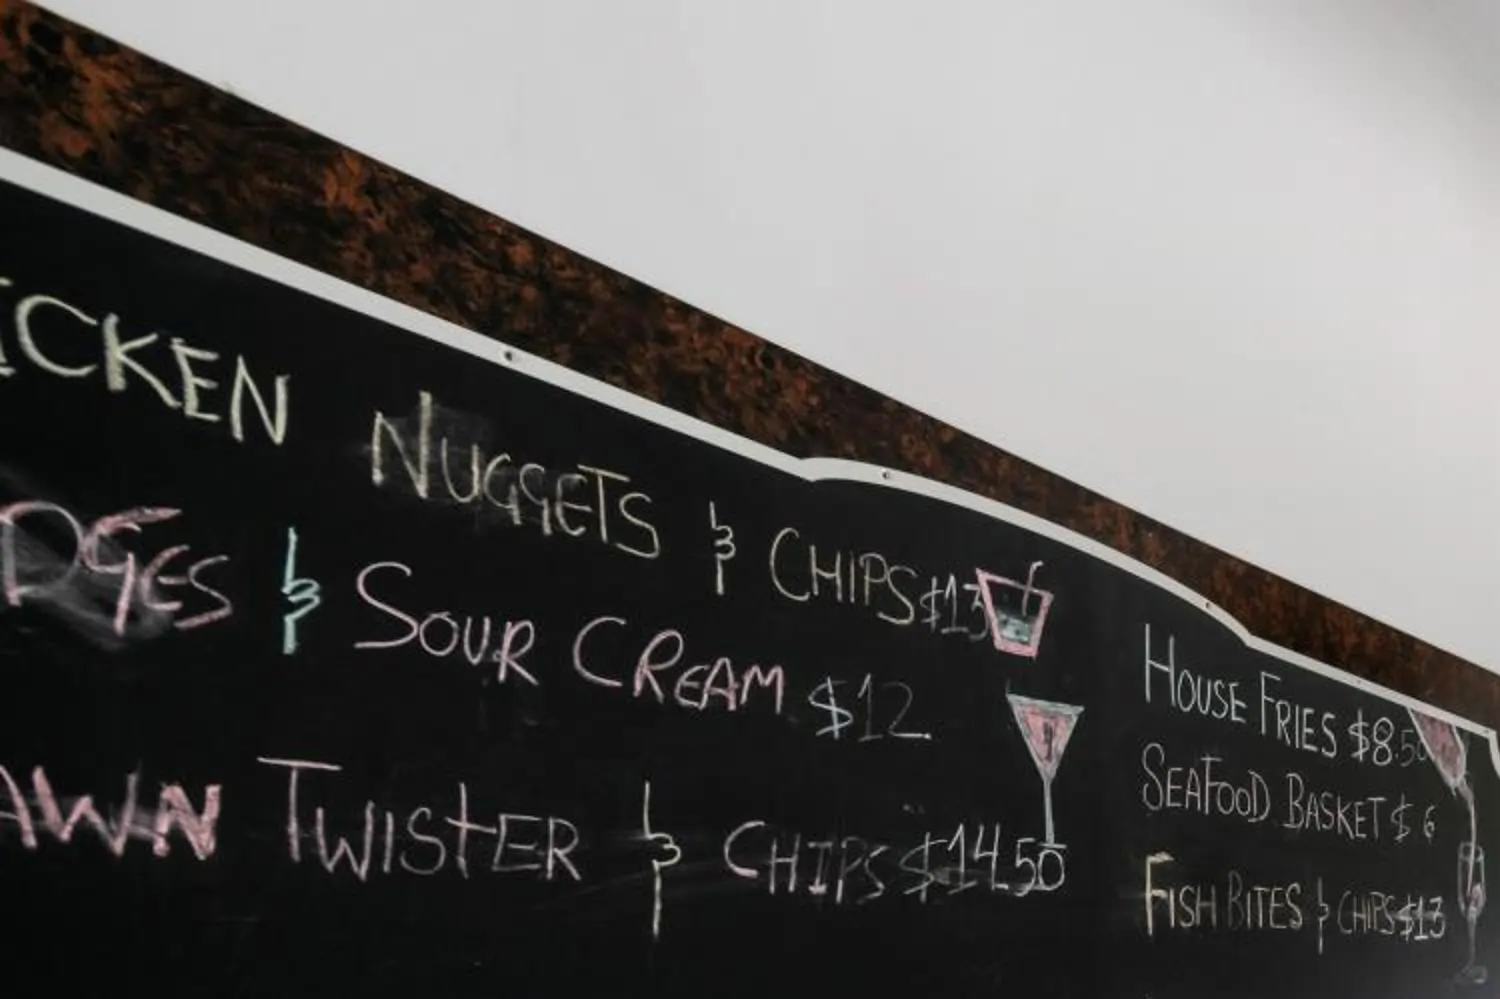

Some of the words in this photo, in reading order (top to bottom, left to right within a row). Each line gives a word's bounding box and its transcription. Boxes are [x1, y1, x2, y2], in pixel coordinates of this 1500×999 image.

[370, 391, 660, 559] NUGGETS
[769, 528, 915, 625] CHIPS
[354, 561, 538, 686] SOUR
[572, 616, 784, 715] CREAM
[808, 673, 931, 738] $12
[1143, 623, 1247, 724] HOUSE
[1259, 671, 1338, 758] FRIES
[257, 756, 581, 882] TWISTER
[723, 820, 888, 902] CHIPS
[1141, 742, 1271, 823] SEAFOOD
[1283, 772, 1387, 840] BASKET
[1145, 851, 1217, 936] FISH
[1226, 870, 1303, 931] BITES
[1337, 890, 1396, 935] CHIPS
[1394, 893, 1447, 944] $13
